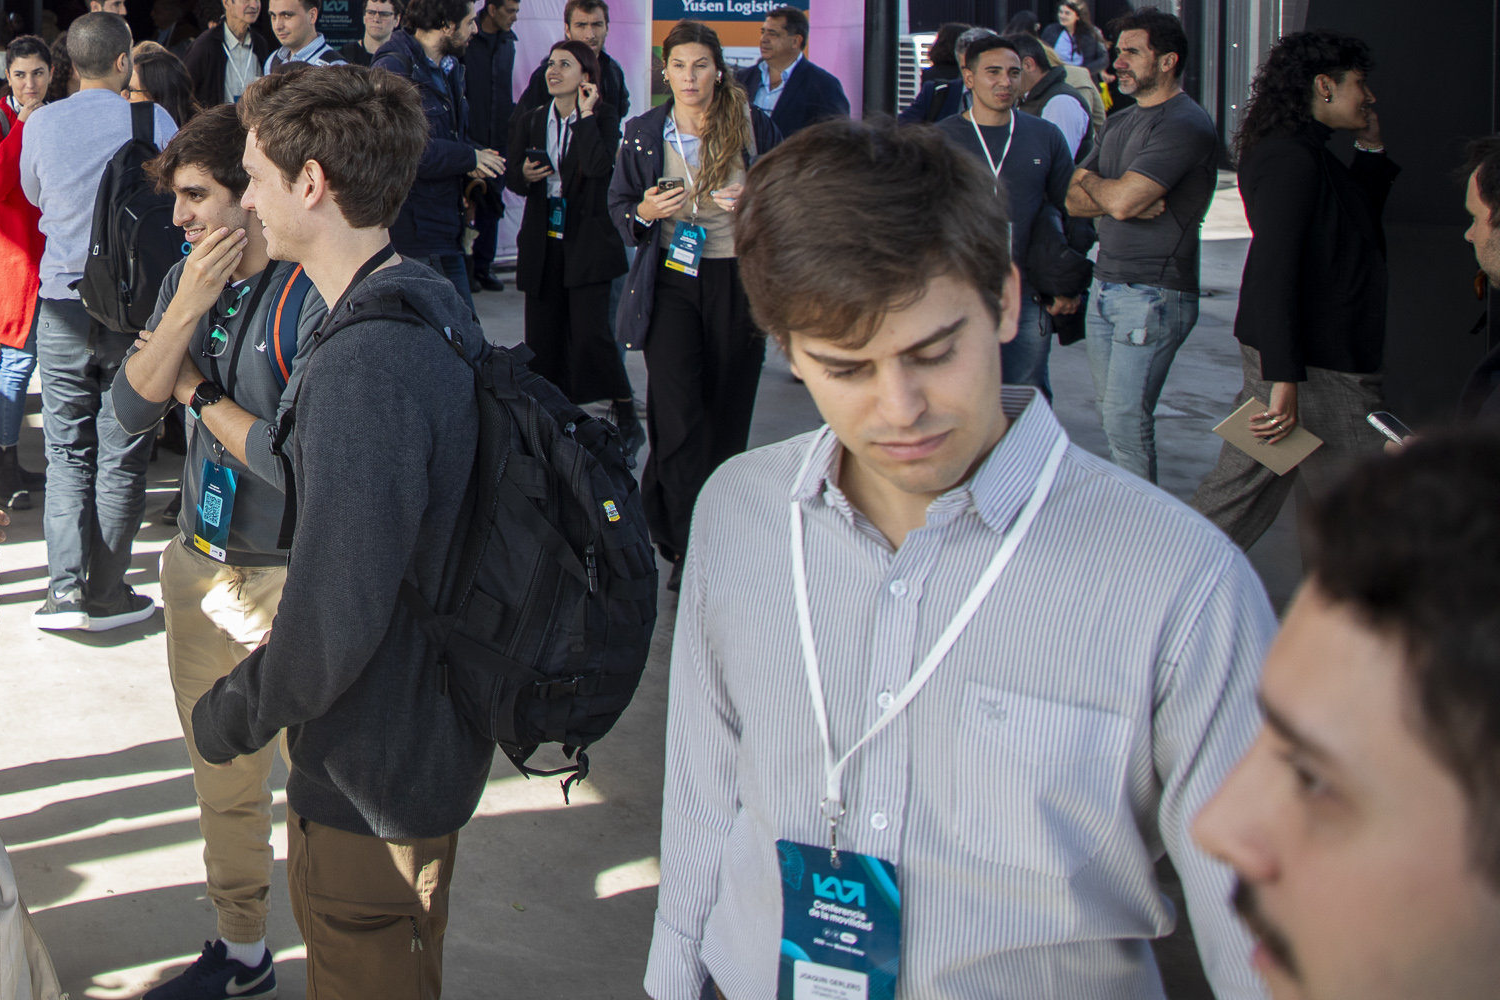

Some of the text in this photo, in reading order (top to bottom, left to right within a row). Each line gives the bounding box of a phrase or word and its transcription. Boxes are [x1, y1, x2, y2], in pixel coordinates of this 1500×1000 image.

[808, 907, 874, 932] de la movilidad
[813, 899, 867, 921] Conferencia
